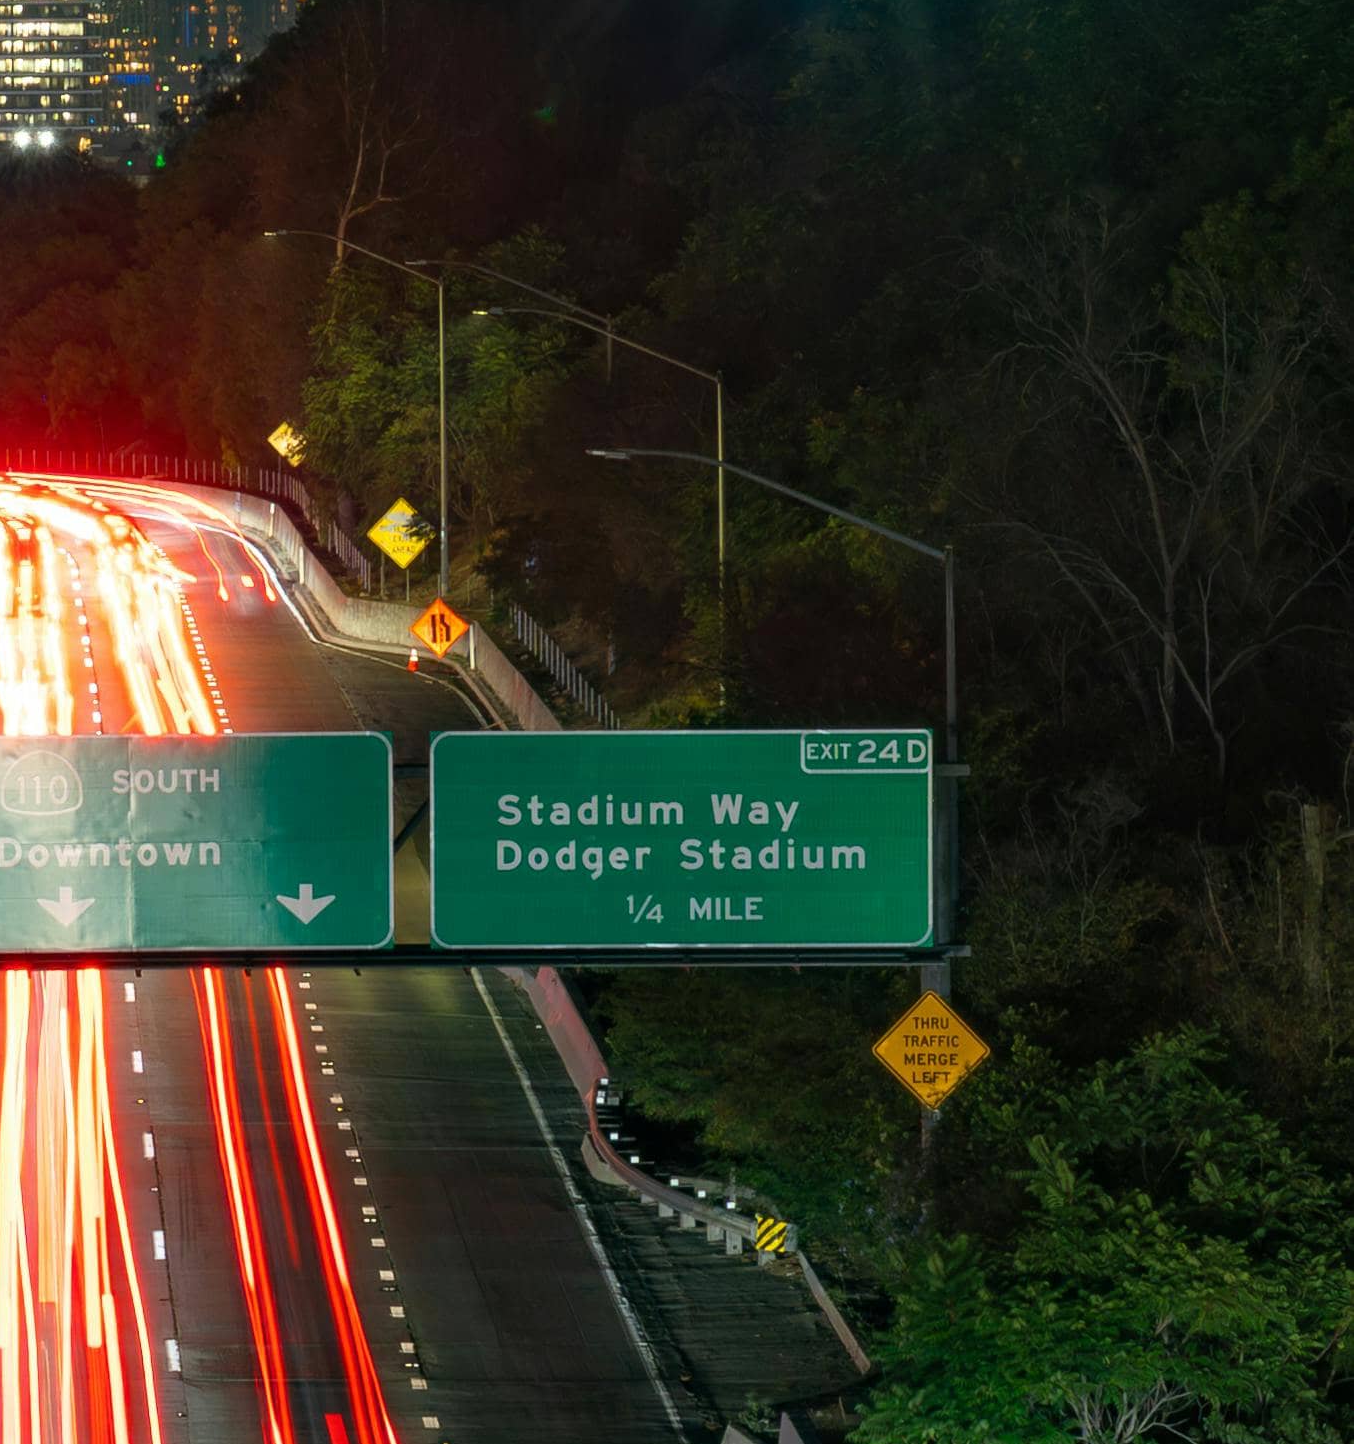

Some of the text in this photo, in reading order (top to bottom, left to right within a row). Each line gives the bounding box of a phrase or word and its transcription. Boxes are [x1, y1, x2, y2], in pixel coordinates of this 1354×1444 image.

[805, 739, 927, 764] EXIT 24D
[16, 774, 70, 805] 110
[111, 768, 221, 795] SOUTH
[497, 793, 800, 833] Stadium Way
[496, 839, 868, 880] Dodger Stadium
[689, 896, 764, 921] MILE
[912, 1016, 950, 1030] THRU
[902, 1034, 960, 1048] TRAFFIC
[903, 1053, 959, 1066] MERGE
[912, 1071, 951, 1084] LEFT
